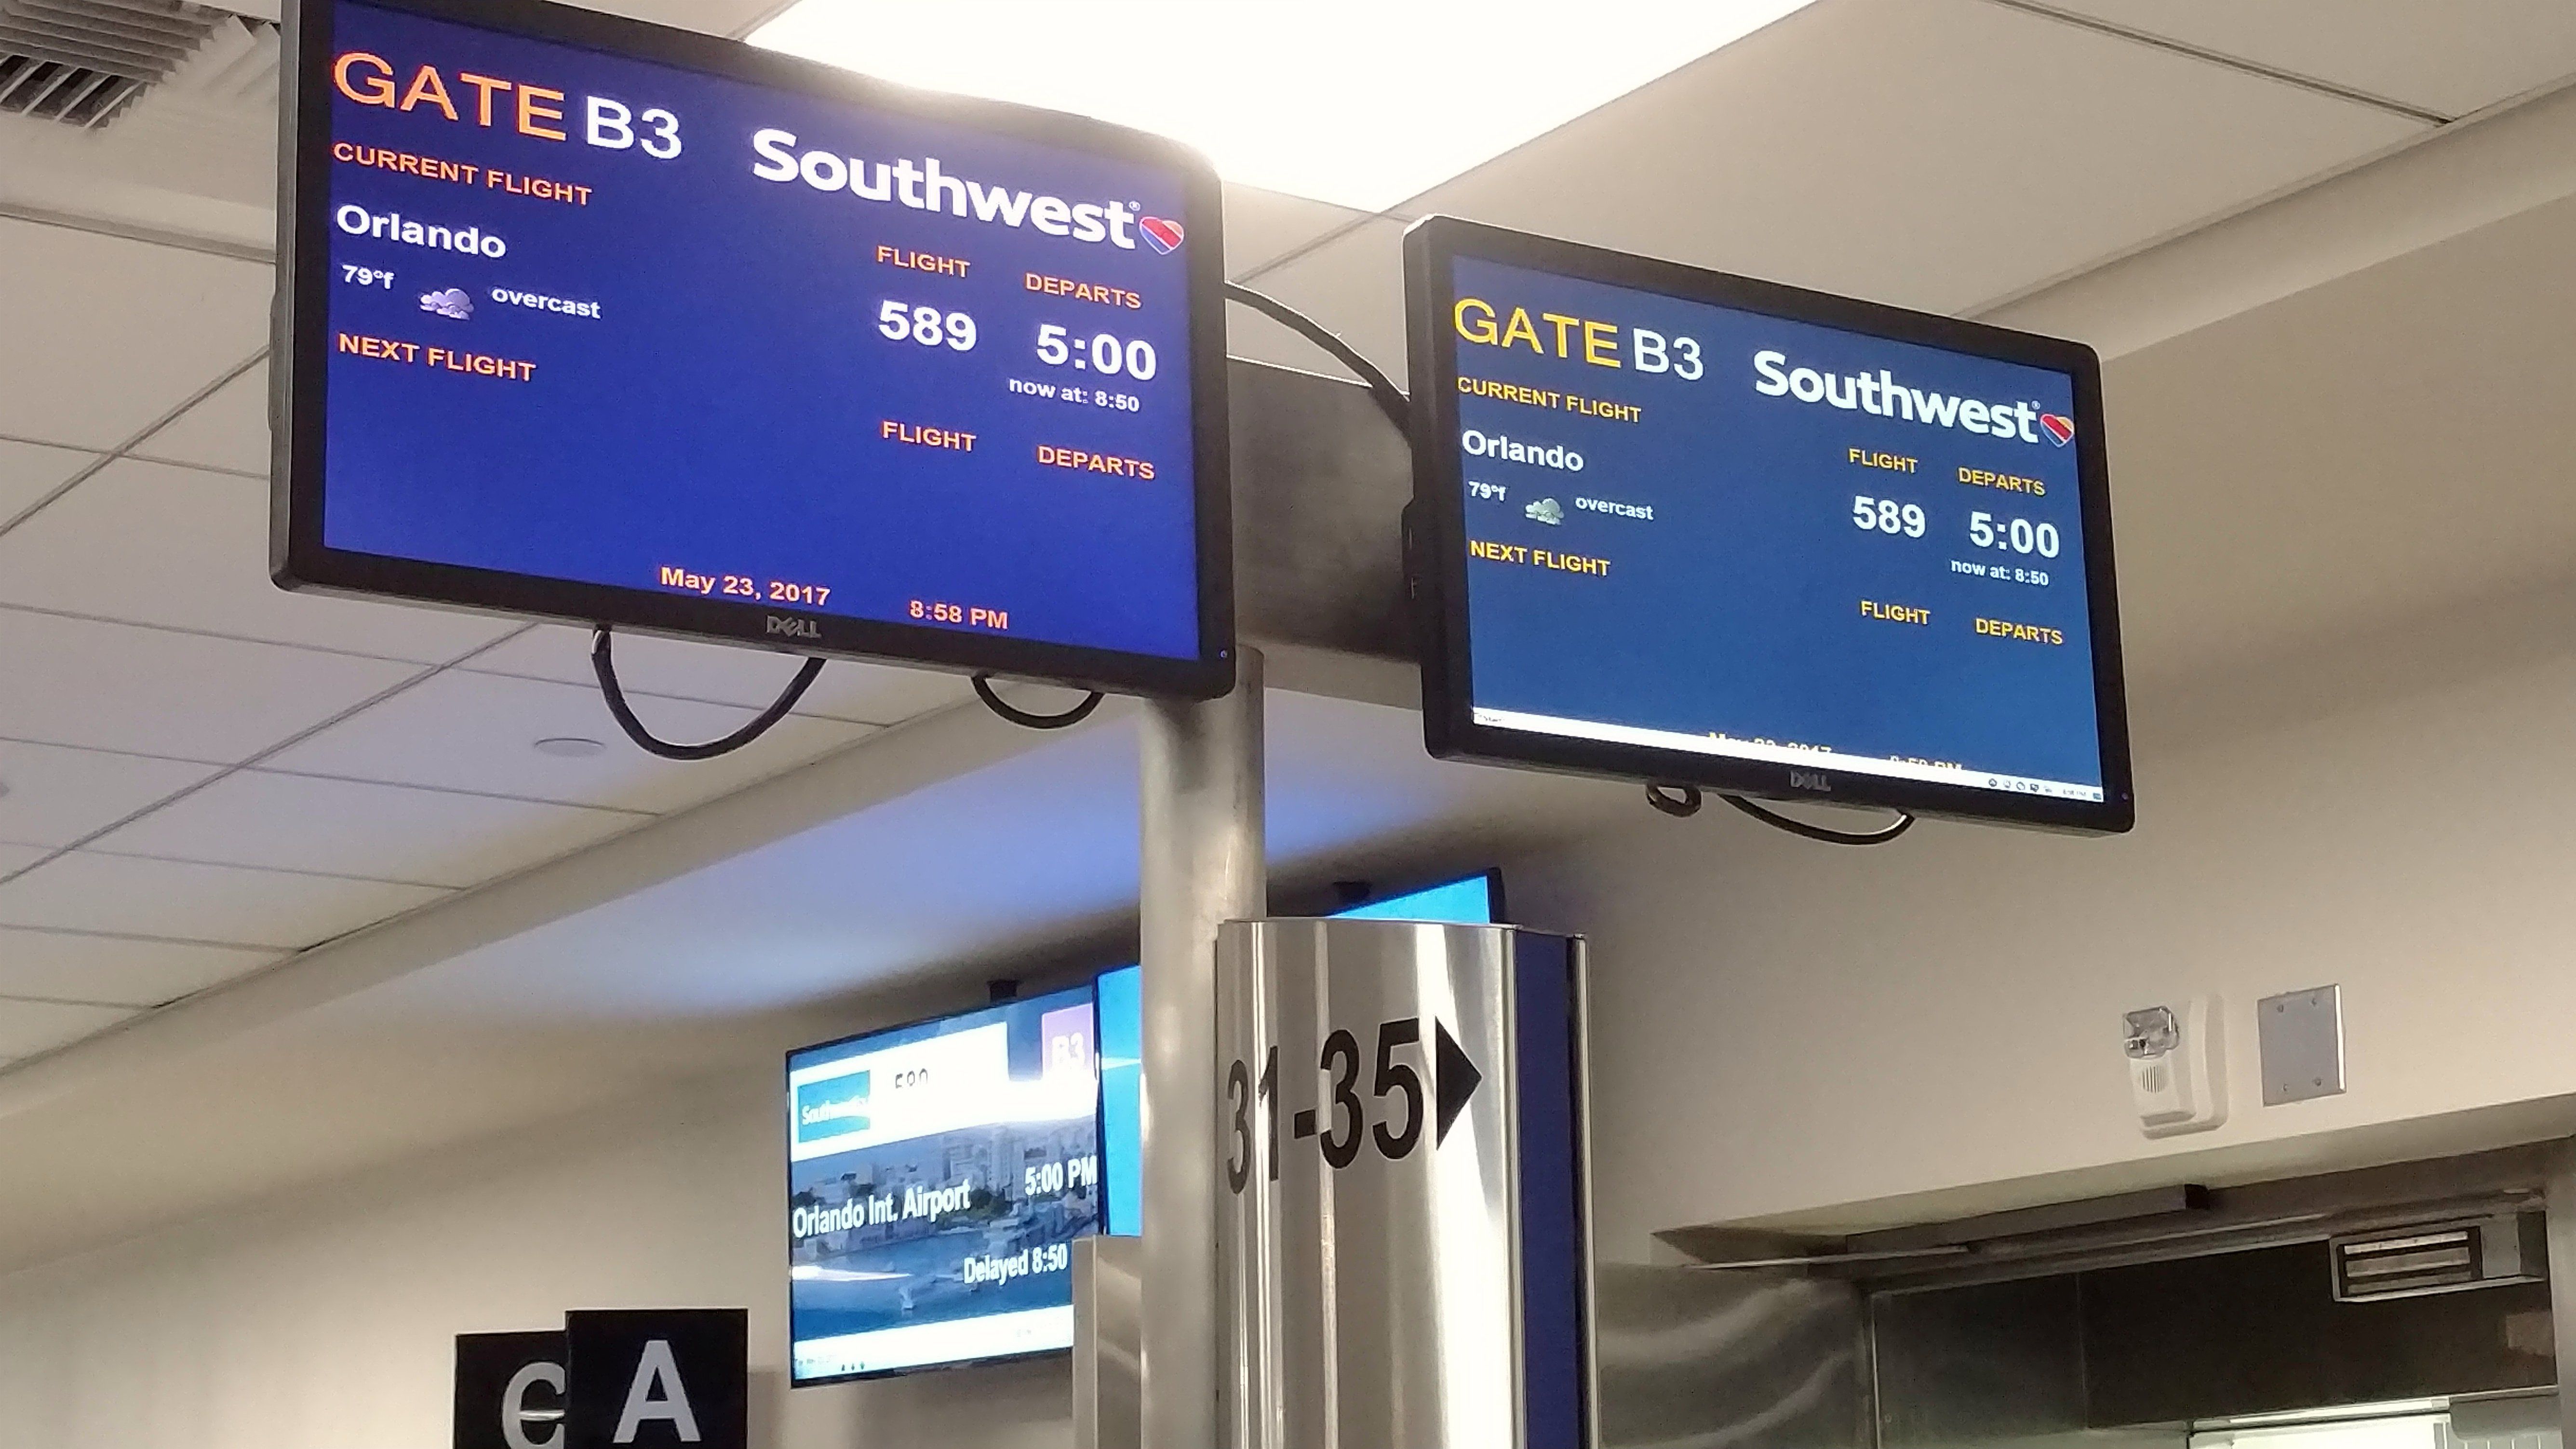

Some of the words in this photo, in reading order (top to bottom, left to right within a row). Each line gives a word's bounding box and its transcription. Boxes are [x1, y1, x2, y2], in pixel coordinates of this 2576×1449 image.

[333, 51, 567, 141] GATE
[587, 95, 682, 160] B3
[333, 143, 479, 185] CURRENT
[487, 170, 592, 206] FLIGHT
[336, 205, 506, 258] Orlando
[877, 245, 971, 278] FLIGHT
[1025, 273, 1141, 309] DEPARTS
[491, 288, 601, 319] overcast
[339, 333, 420, 363] NEXT
[428, 347, 537, 382] FLIGHT
[878, 300, 977, 351] 589
[1036, 323, 1156, 381] 5:00
[1454, 298, 1621, 368] GATE
[1633, 328, 1704, 381] B3
[1009, 378, 1056, 399] now
[1060, 386, 1089, 404] at:
[1094, 390, 1140, 412] 8:50
[1457, 376, 1560, 409] CURRENT
[1566, 395, 1641, 423] FLIGHT
[882, 421, 977, 452] FLIGHT
[1038, 446, 1155, 480] DEPARTS
[1462, 429, 1584, 471] Orlando
[1849, 448, 1919, 473] FLIGHT
[1958, 467, 2045, 496] DEPARTS
[1575, 496, 1654, 521] overcast
[1852, 495, 1926, 538] 589
[1969, 511, 2060, 558] 5:00
[1470, 540, 1528, 563] NEXT
[1533, 550, 1610, 577] FLIGHT
[1950, 560, 1986, 577] now
[1989, 565, 2011, 581] at:
[2014, 568, 2049, 586] 8:50
[661, 566, 716, 595] May
[723, 575, 761, 601] 23,
[769, 581, 831, 606] 2017
[766, 615, 822, 639] DELL
[910, 600, 963, 623] 8:58
[970, 607, 1008, 630] PM
[1861, 601, 1931, 625] FLIGHT
[1975, 617, 2063, 645] DEPARTS
[1227, 1018, 1423, 1194] 31-35
[1025, 1161, 1063, 1197] 5:00
[1068, 1155, 1098, 1190] PM
[792, 1198, 865, 1238] Orlando
[869, 1192, 899, 1224] Int.
[902, 1180, 971, 1225] Airport
[964, 1250, 1029, 1287] Delayed
[1032, 1244, 1067, 1273] 8:50
[613, 1340, 702, 1443] A
